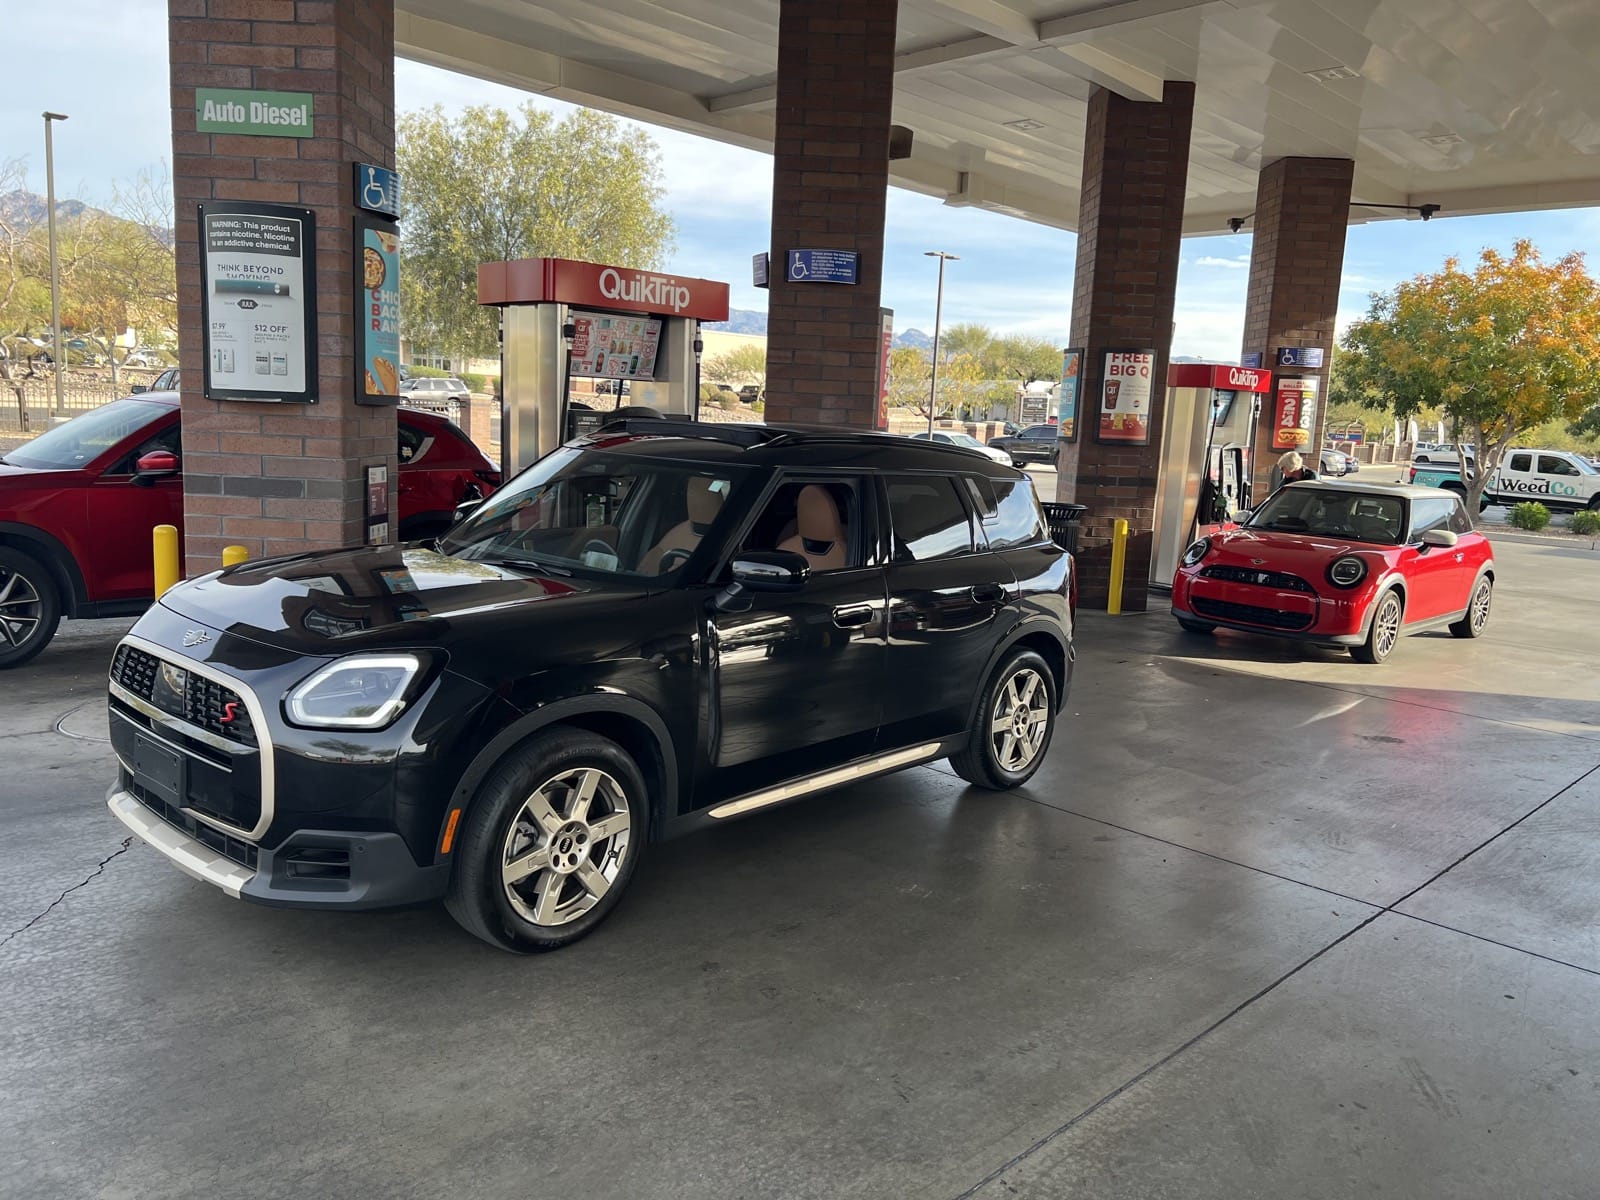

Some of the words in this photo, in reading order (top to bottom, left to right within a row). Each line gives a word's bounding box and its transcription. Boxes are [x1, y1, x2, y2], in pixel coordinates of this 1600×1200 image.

[203, 99, 245, 123] Auto
[250, 101, 307, 126] Diesel
[261, 224, 290, 233] product
[232, 231, 262, 239] nicotine.
[264, 233, 295, 242] Nicotine
[255, 242, 292, 251] chemical.
[217, 264, 240, 272] THINK
[243, 264, 284, 275] BEYOND
[599, 268, 690, 313] QuikTrip
[254, 324, 268, 332] $12
[1111, 352, 1150, 364] FREE
[1110, 365, 1136, 376] BIG
[1140, 365, 1149, 379] Q
[1229, 367, 1259, 390] QuikTrip
[1284, 398, 1296, 411] 2
[219, 701, 240, 723] S
